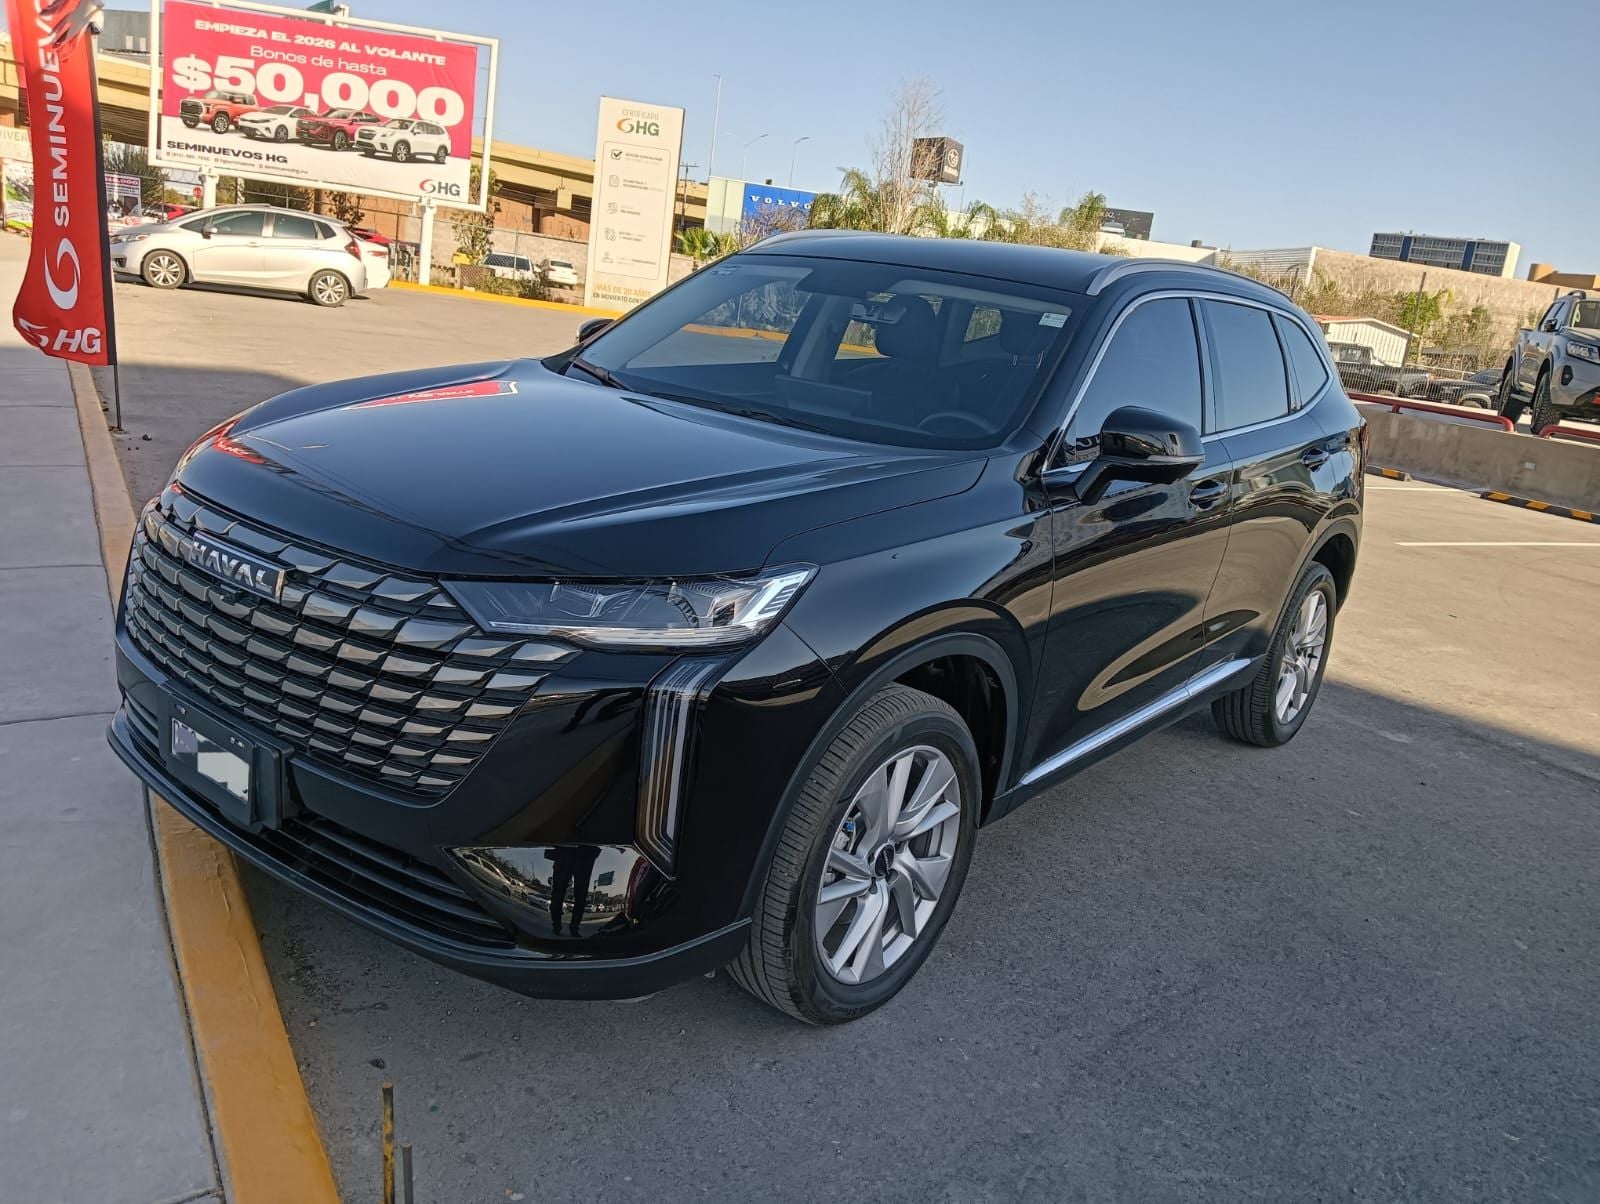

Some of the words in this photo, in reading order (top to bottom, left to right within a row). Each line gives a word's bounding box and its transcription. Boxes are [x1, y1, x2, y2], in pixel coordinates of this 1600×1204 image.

[194, 19, 268, 39] EMPIEZA
[271, 31, 291, 42] EL
[294, 34, 336, 49] 2026
[339, 42, 360, 53] AL
[364, 45, 446, 66] VOLANTE
[250, 45, 307, 64] Bonos
[311, 54, 334, 68] de
[338, 57, 387, 76] hasta
[172, 53, 465, 127] $50,000
[635, 120, 660, 136] HG
[167, 140, 263, 160] SEMINUEVOS
[266, 153, 288, 164] HG
[437, 181, 461, 197] HG
[750, 195, 812, 210] VOLVO
[53, 326, 101, 354] HG
[191, 541, 273, 596] HAVAL
